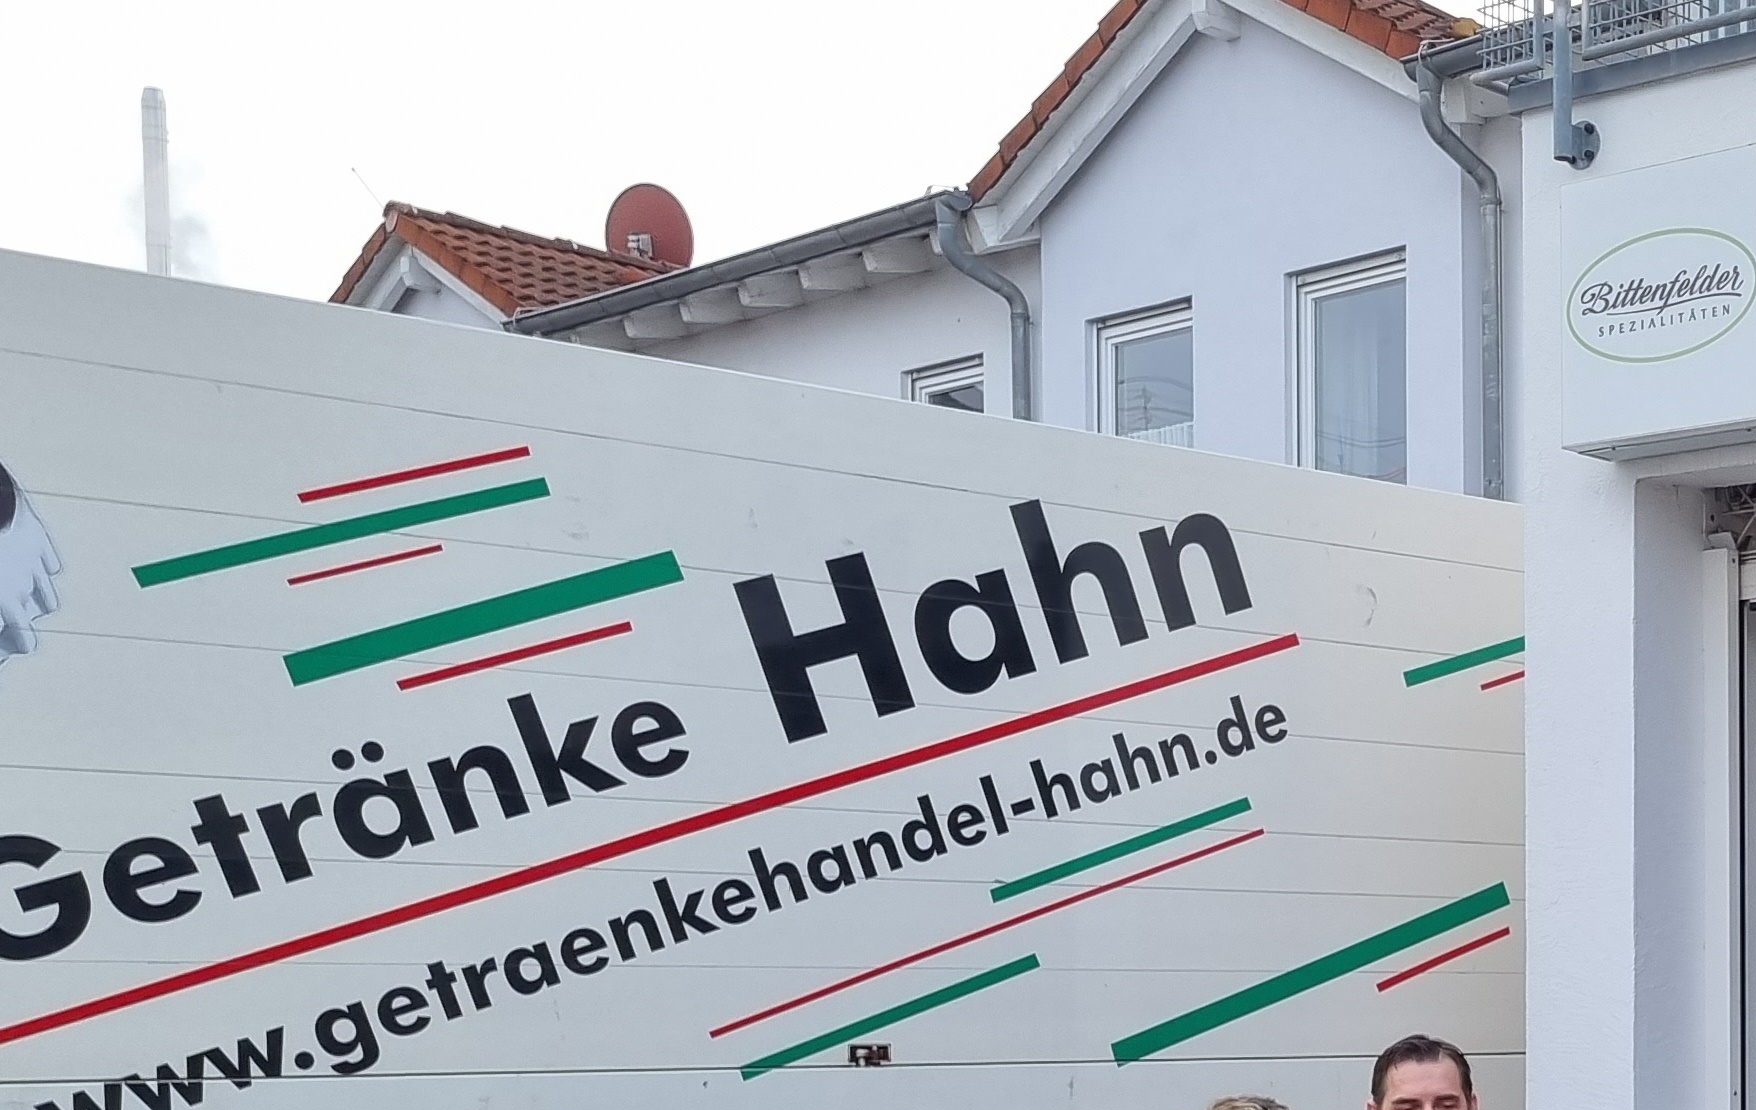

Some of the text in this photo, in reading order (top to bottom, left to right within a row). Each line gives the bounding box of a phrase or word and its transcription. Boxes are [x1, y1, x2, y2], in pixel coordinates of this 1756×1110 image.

[1581, 262, 1745, 316] Bittenfelder
[1598, 303, 1732, 338] SPEZIALITÄTEN
[0, 498, 1253, 961] Getränke Hahn
